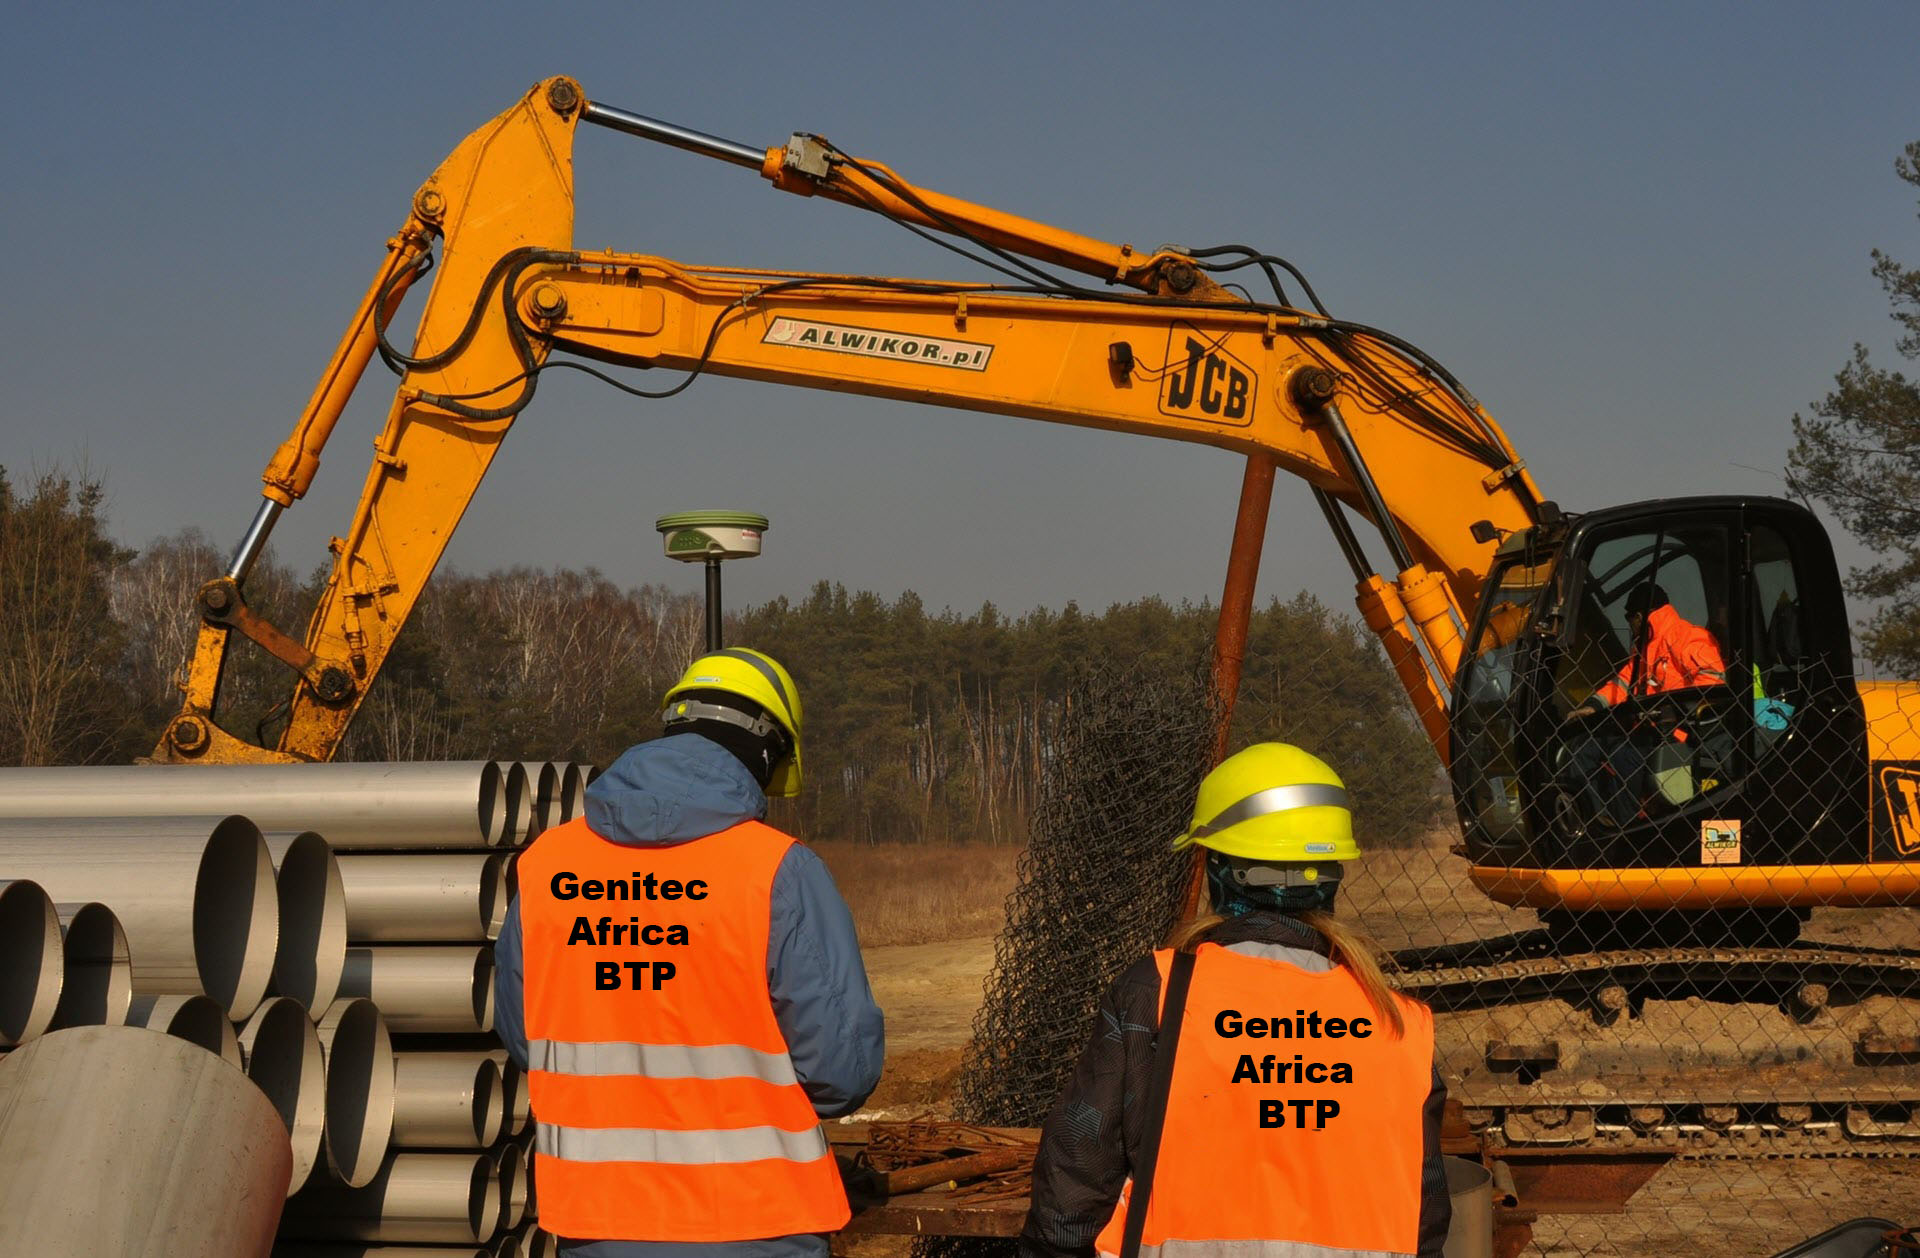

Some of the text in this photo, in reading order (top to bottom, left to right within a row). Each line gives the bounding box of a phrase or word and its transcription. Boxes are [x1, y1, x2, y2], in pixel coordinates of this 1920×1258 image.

[799, 327, 983, 365] ALWIKOR.pl
[1167, 335, 1249, 419] JCB
[551, 872, 708, 900] Genitec
[567, 917, 689, 945] Africa
[595, 962, 676, 990] BTP
[1215, 1010, 1372, 1038] Genitec
[1231, 1055, 1353, 1083] Africa
[1259, 1100, 1340, 1128] BTP
